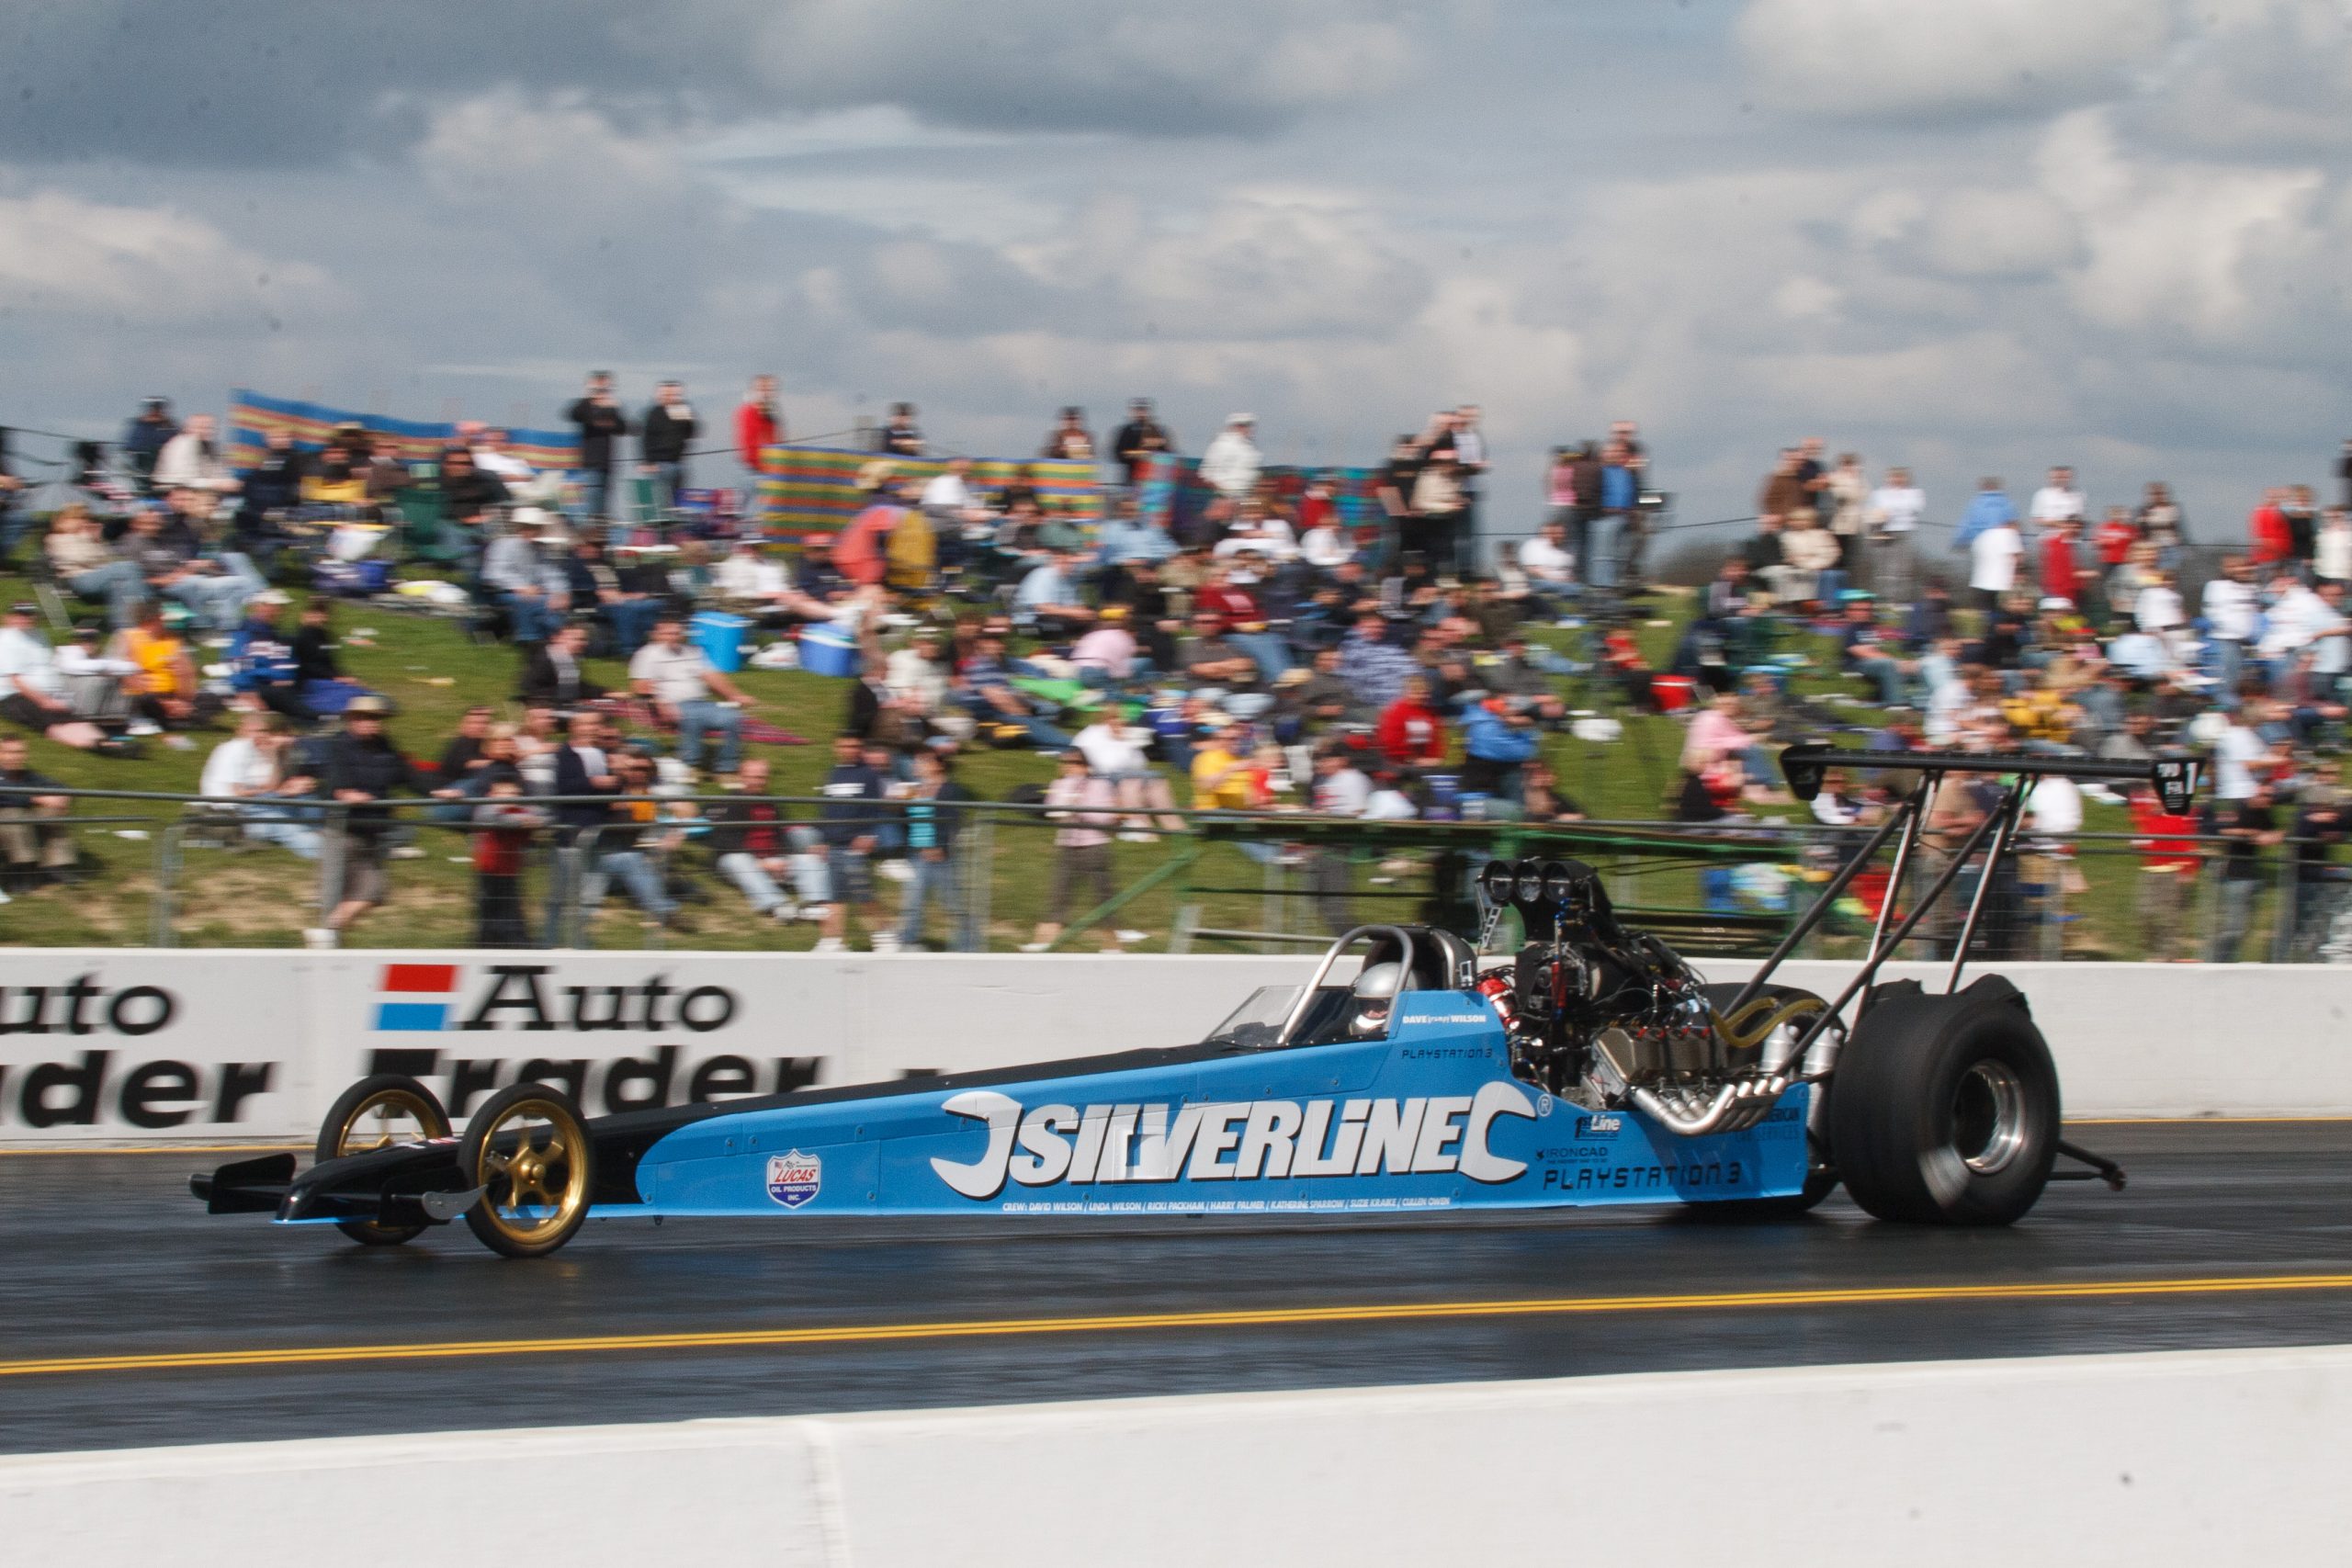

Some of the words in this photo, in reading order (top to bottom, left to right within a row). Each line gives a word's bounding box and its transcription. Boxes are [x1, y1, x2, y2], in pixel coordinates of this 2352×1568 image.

[459, 967, 739, 1032] Auto
[1402, 1015, 1427, 1023] DAVE
[1451, 1014, 1487, 1022] WILSON
[1402, 1048, 1483, 1059] PLAYSTATION
[1485, 1048, 1493, 1058] 3
[0, 1049, 278, 1129] der
[1546, 1146, 1608, 1158] IRONCAD
[775, 1168, 817, 1183] LUCAS
[1543, 1162, 1722, 1190] PLAYSTATION
[1727, 1160, 1741, 1184] 3
[784, 1184, 817, 1192] PRODUCTS
[1002, 1202, 1027, 1212] CREW:
[1029, 1202, 1051, 1212] DAVID
[1053, 1202, 1083, 1212] WILSON
[1089, 1202, 1111, 1212] LINDA
[1112, 1202, 1141, 1212] WILSON
[1210, 1201, 1236, 1210] HARRY
[1237, 1201, 1265, 1210] PALMER
[1271, 1201, 1309, 1210] KATHERINE
[1309, 1200, 1345, 1209] SPARROW
[1402, 1198, 1427, 1206] CULLEN
[1428, 1197, 1451, 1205] OWEN
